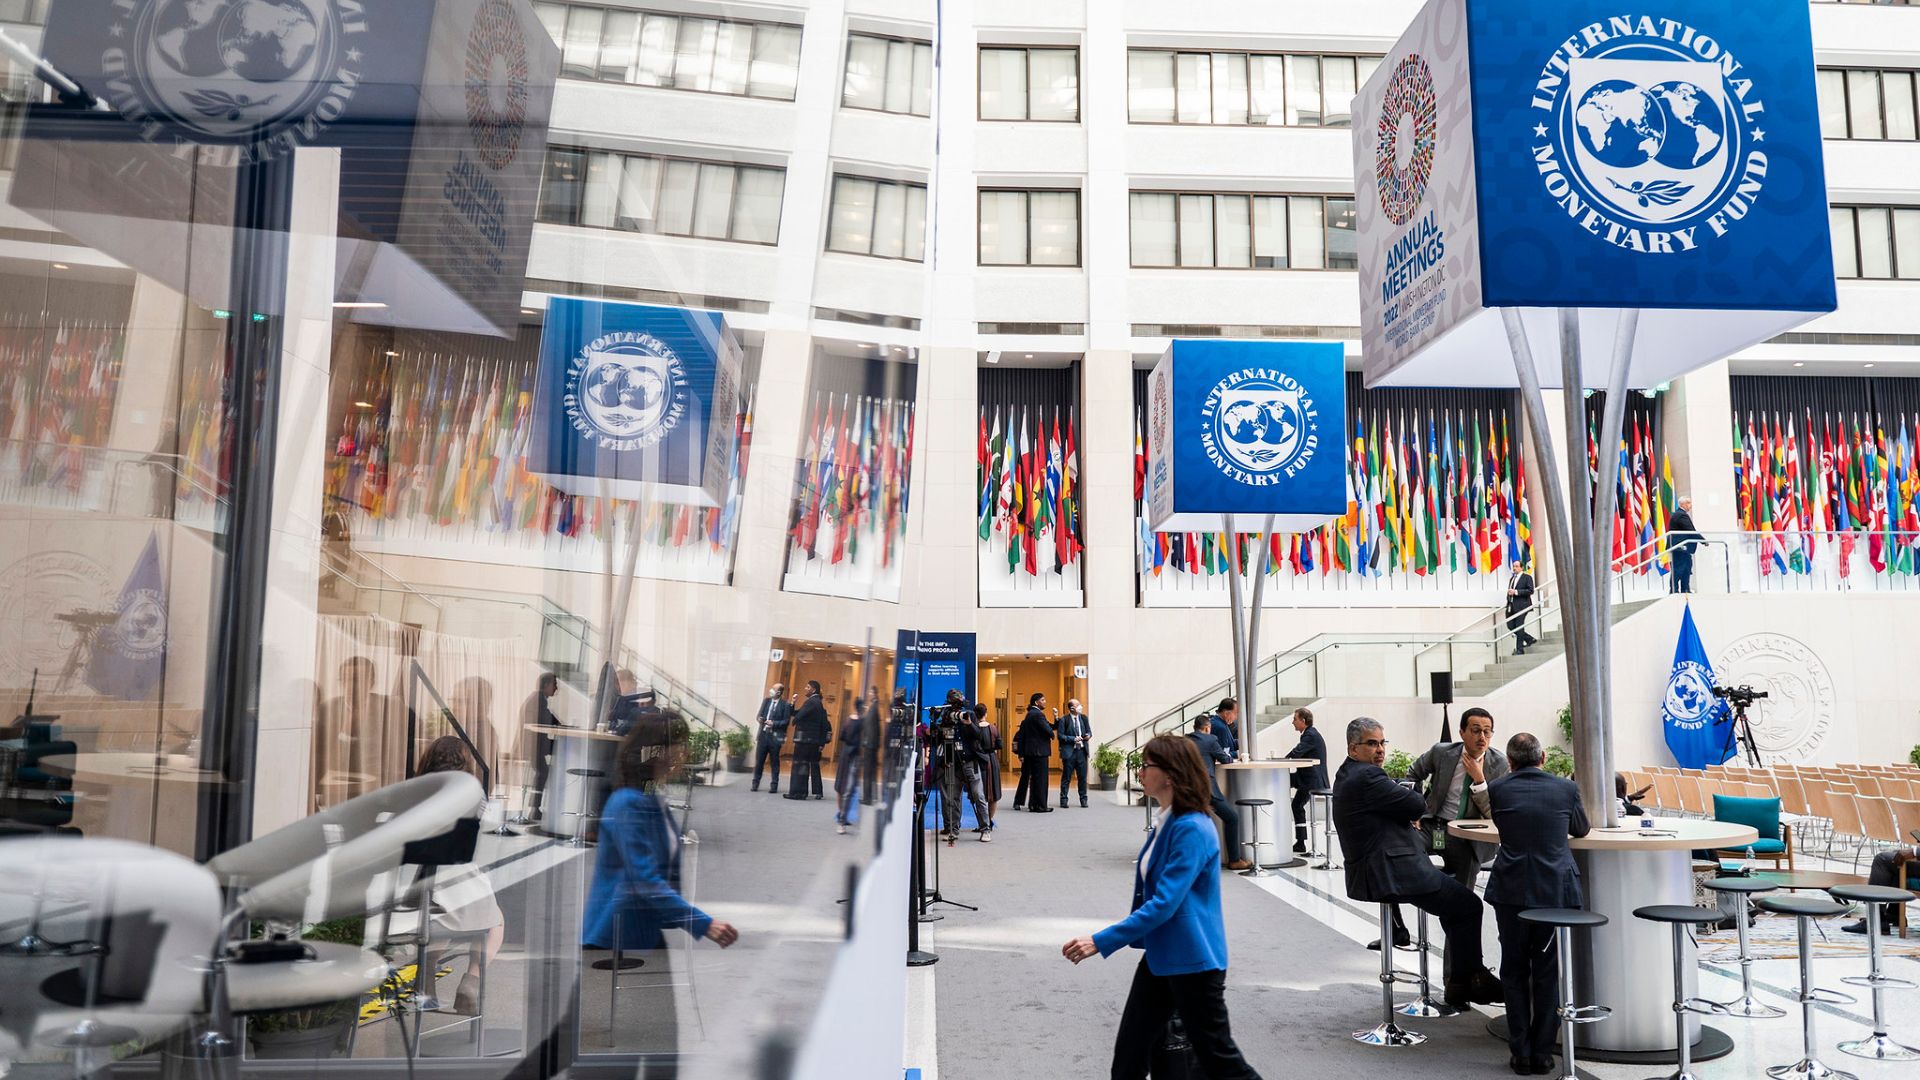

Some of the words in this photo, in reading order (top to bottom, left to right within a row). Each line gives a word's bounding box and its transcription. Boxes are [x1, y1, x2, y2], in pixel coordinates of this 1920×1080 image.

[1531, 15, 1765, 122] INTERNATIONAL
[1532, 143, 1698, 253] MONETARY
[1705, 151, 1768, 238] FUND
[1383, 232, 1444, 305] MEETINGS
[1386, 210, 1438, 276] ANNUAL
[1384, 303, 1398, 327] 2022
[1402, 274, 1437, 313] WASHINGTON
[1437, 265, 1446, 285] DC
[1201, 368, 1318, 422] INTERNATIONAL
[1201, 432, 1281, 486] MONETARY
[1284, 435, 1318, 478] FUND
[1674, 720, 1703, 730] FUND
